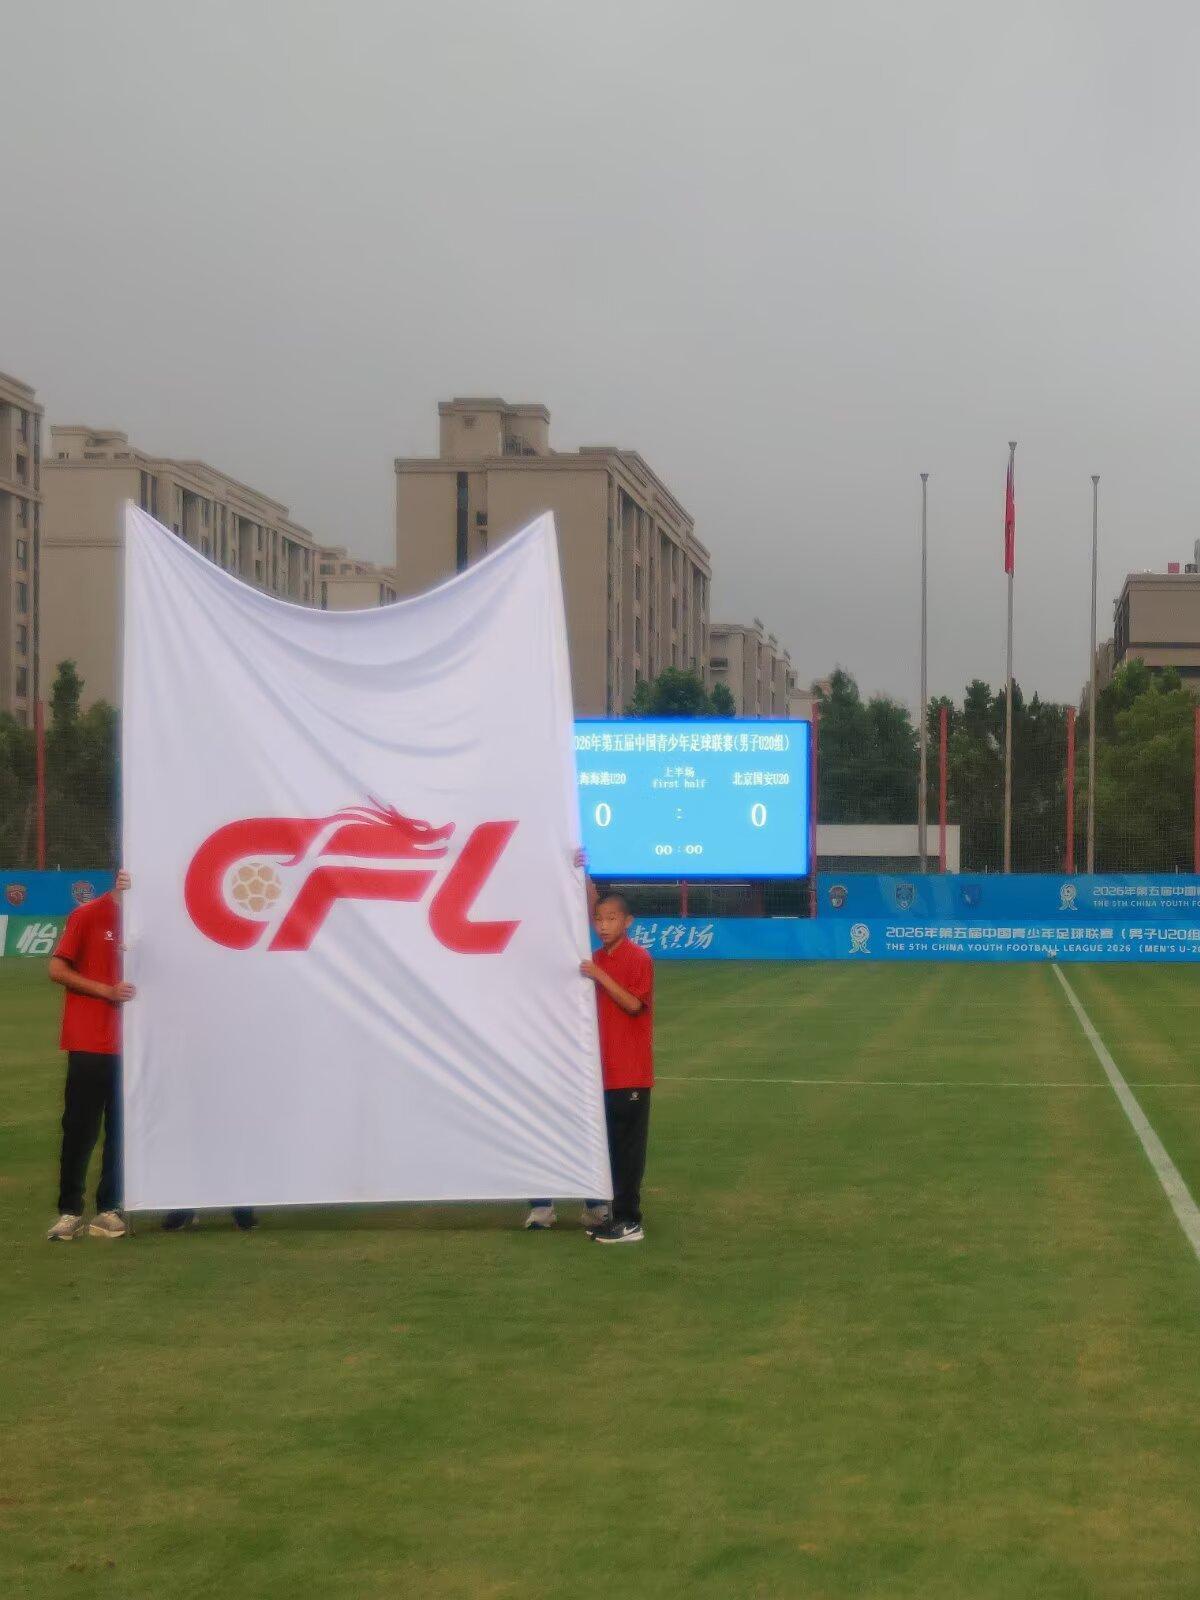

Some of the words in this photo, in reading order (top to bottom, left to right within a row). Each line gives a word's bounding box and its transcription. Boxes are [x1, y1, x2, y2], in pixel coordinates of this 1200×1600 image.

[574, 733, 790, 752] 026年第五届中国青少年足球联赛(男子U20组)
[577, 772, 627, 785] 海海港U20
[665, 766, 695, 778] 上半场
[733, 772, 790, 785] 北京国安U20
[653, 779, 680, 788] first
[684, 779, 707, 788] half
[595, 803, 611, 827] 0
[751, 803, 767, 827] 0
[655, 845, 672, 855] 00
[686, 844, 703, 855] 00
[184, 795, 522, 954] CFL
[17, 923, 58, 953] 怡
[630, 923, 714, 949] 起登场
[886, 943, 905, 951] THE
[909, 943, 928, 951] 5TH
[932, 943, 963, 951] CHINA
[968, 943, 1003, 952] YOUTH
[1006, 944, 1059, 952] FOOTBALL
[1063, 944, 1103, 952] LEAGUE
[1106, 944, 1131, 952] 2026
